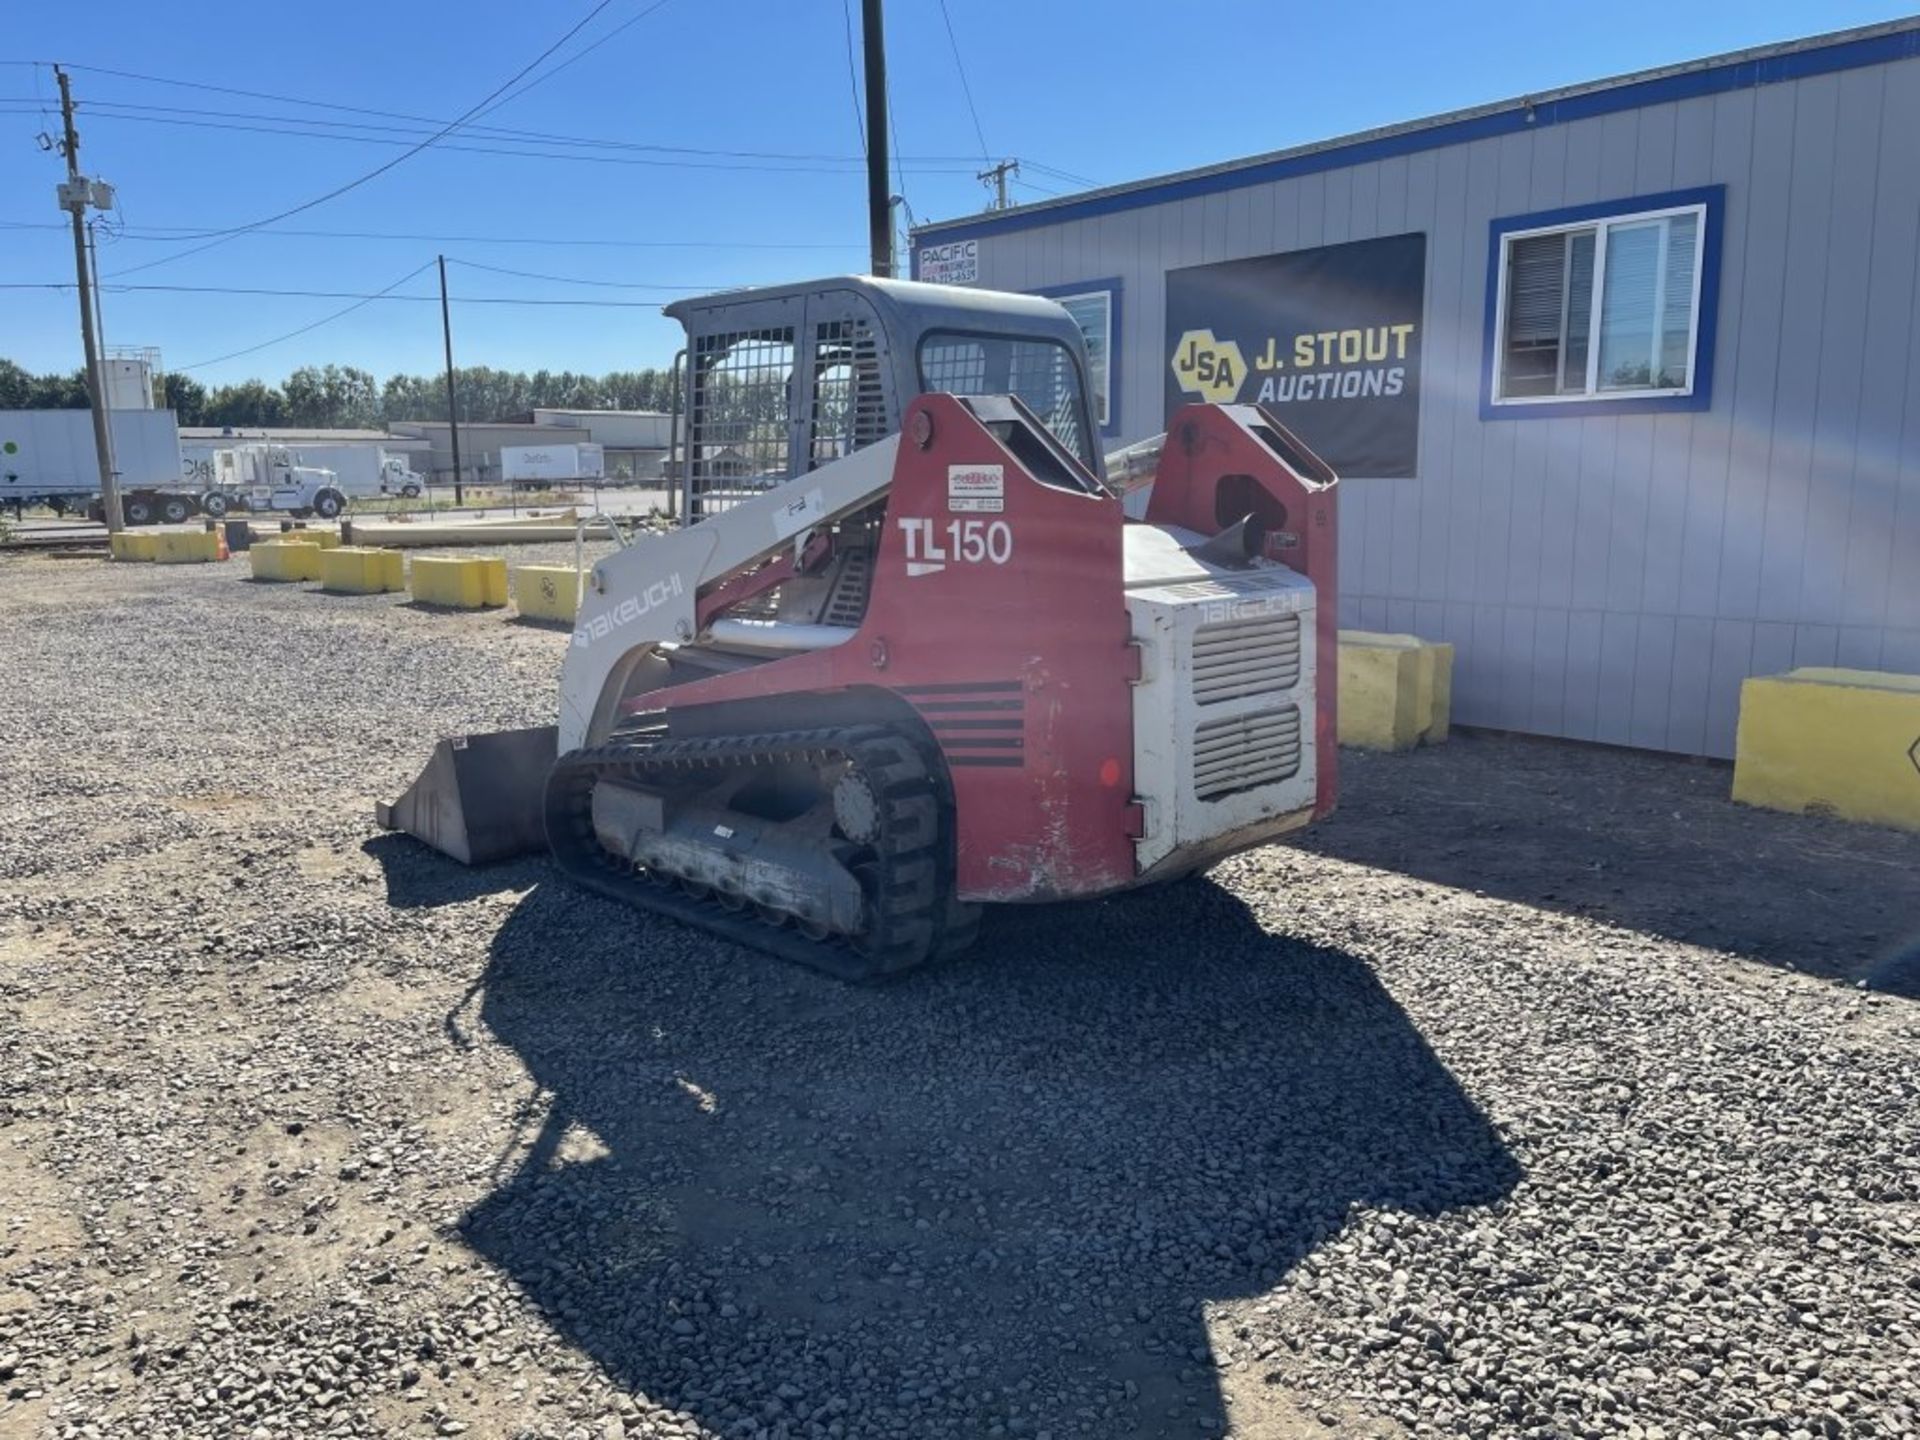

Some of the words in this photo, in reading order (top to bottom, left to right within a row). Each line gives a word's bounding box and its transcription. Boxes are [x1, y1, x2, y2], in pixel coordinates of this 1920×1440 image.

[922, 242, 976, 264] PACIFIC
[1180, 341, 1234, 389] JSA
[1256, 338, 1283, 370] J.
[1295, 324, 1414, 367] STOUT
[1258, 368, 1405, 403] AUCTIONS
